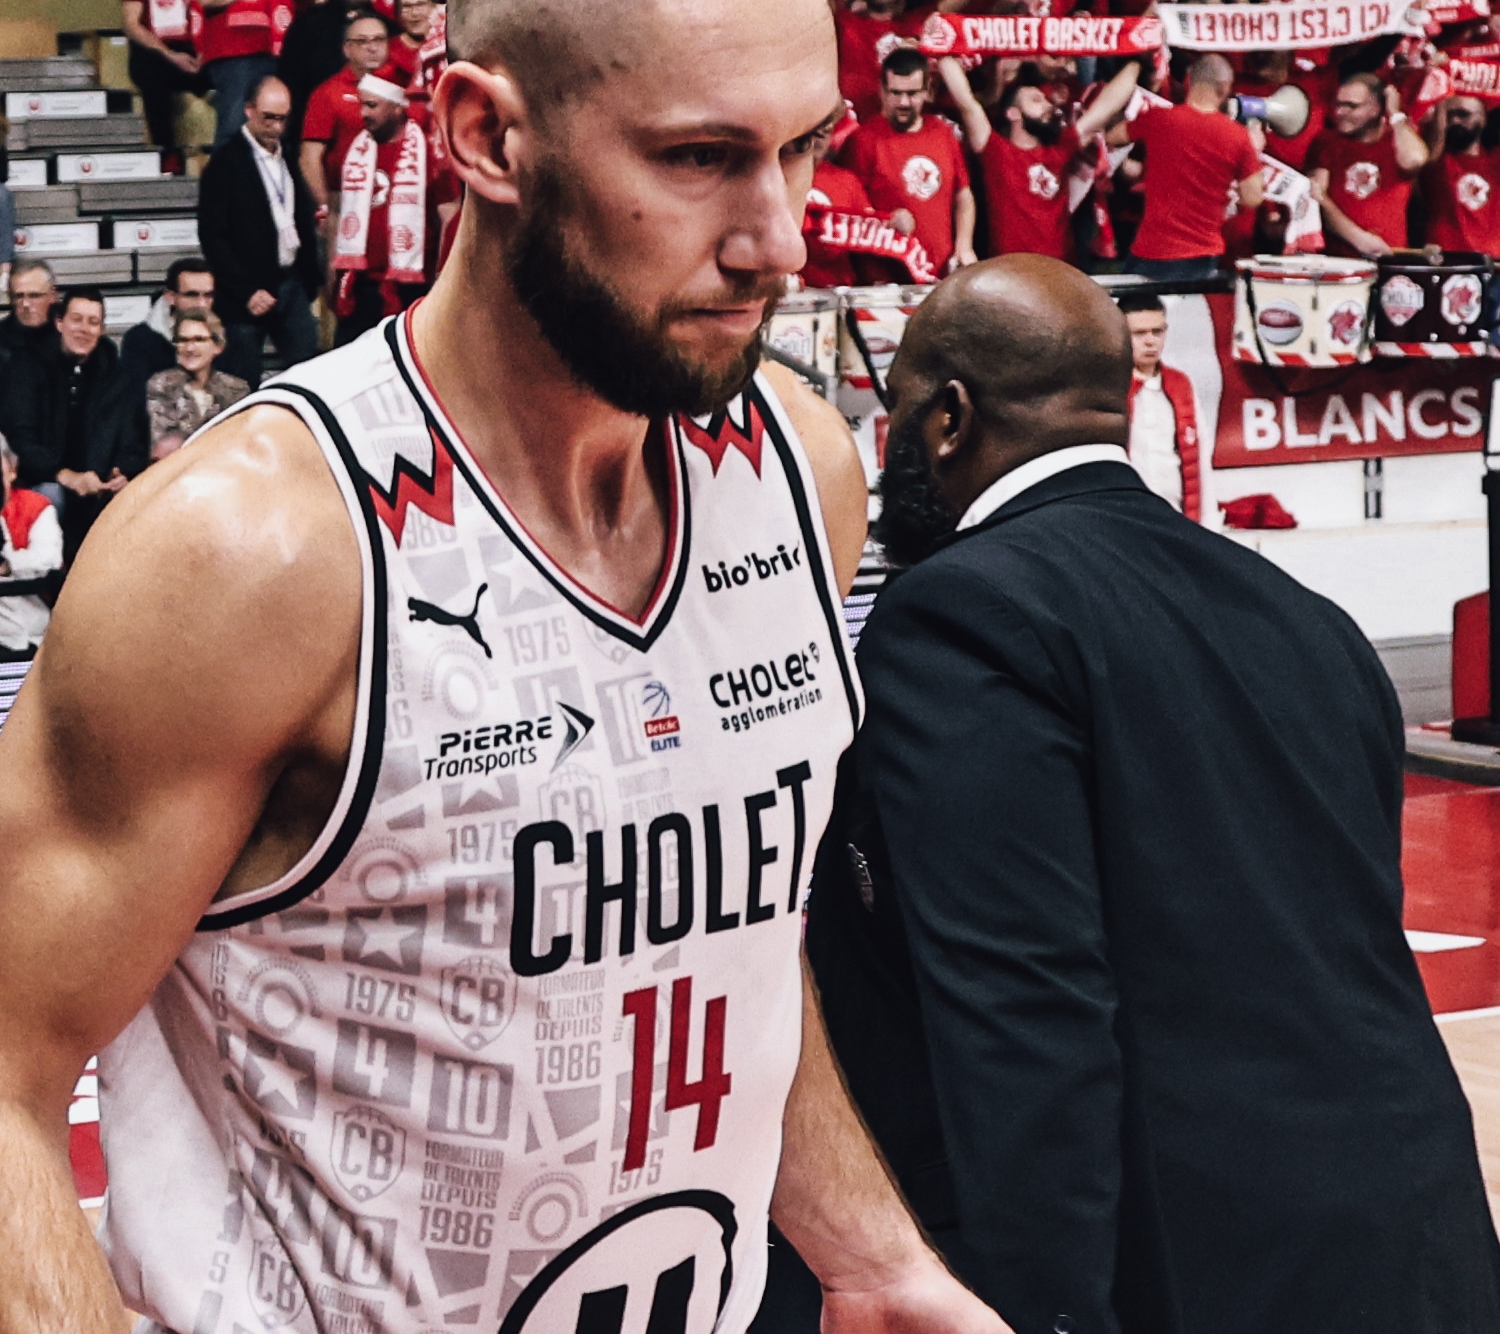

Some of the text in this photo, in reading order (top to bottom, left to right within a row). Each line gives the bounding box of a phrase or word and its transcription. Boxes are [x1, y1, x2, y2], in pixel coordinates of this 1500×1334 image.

[962, 17, 1125, 51] CHOLET BASKET
[1192, 10, 1279, 42] CHOLET
[1241, 387, 1483, 451] BLANCS
[503, 616, 572, 666] 1975
[720, 687, 824, 733] agglomération
[423, 745, 538, 783] Transports
[510, 760, 813, 978] CHOLET
[344, 973, 417, 1023] 1975
[452, 976, 506, 1027] CB
[535, 1017, 601, 1041] DEPUIS
[354, 1024, 389, 1098] 4
[535, 1041, 602, 1085] 1986
[622, 976, 732, 1173] 14
[445, 1058, 495, 1136] 10
[340, 1121, 395, 1182] CB
[420, 1184, 498, 1209] DEPUIS
[419, 1205, 494, 1249] 1986
